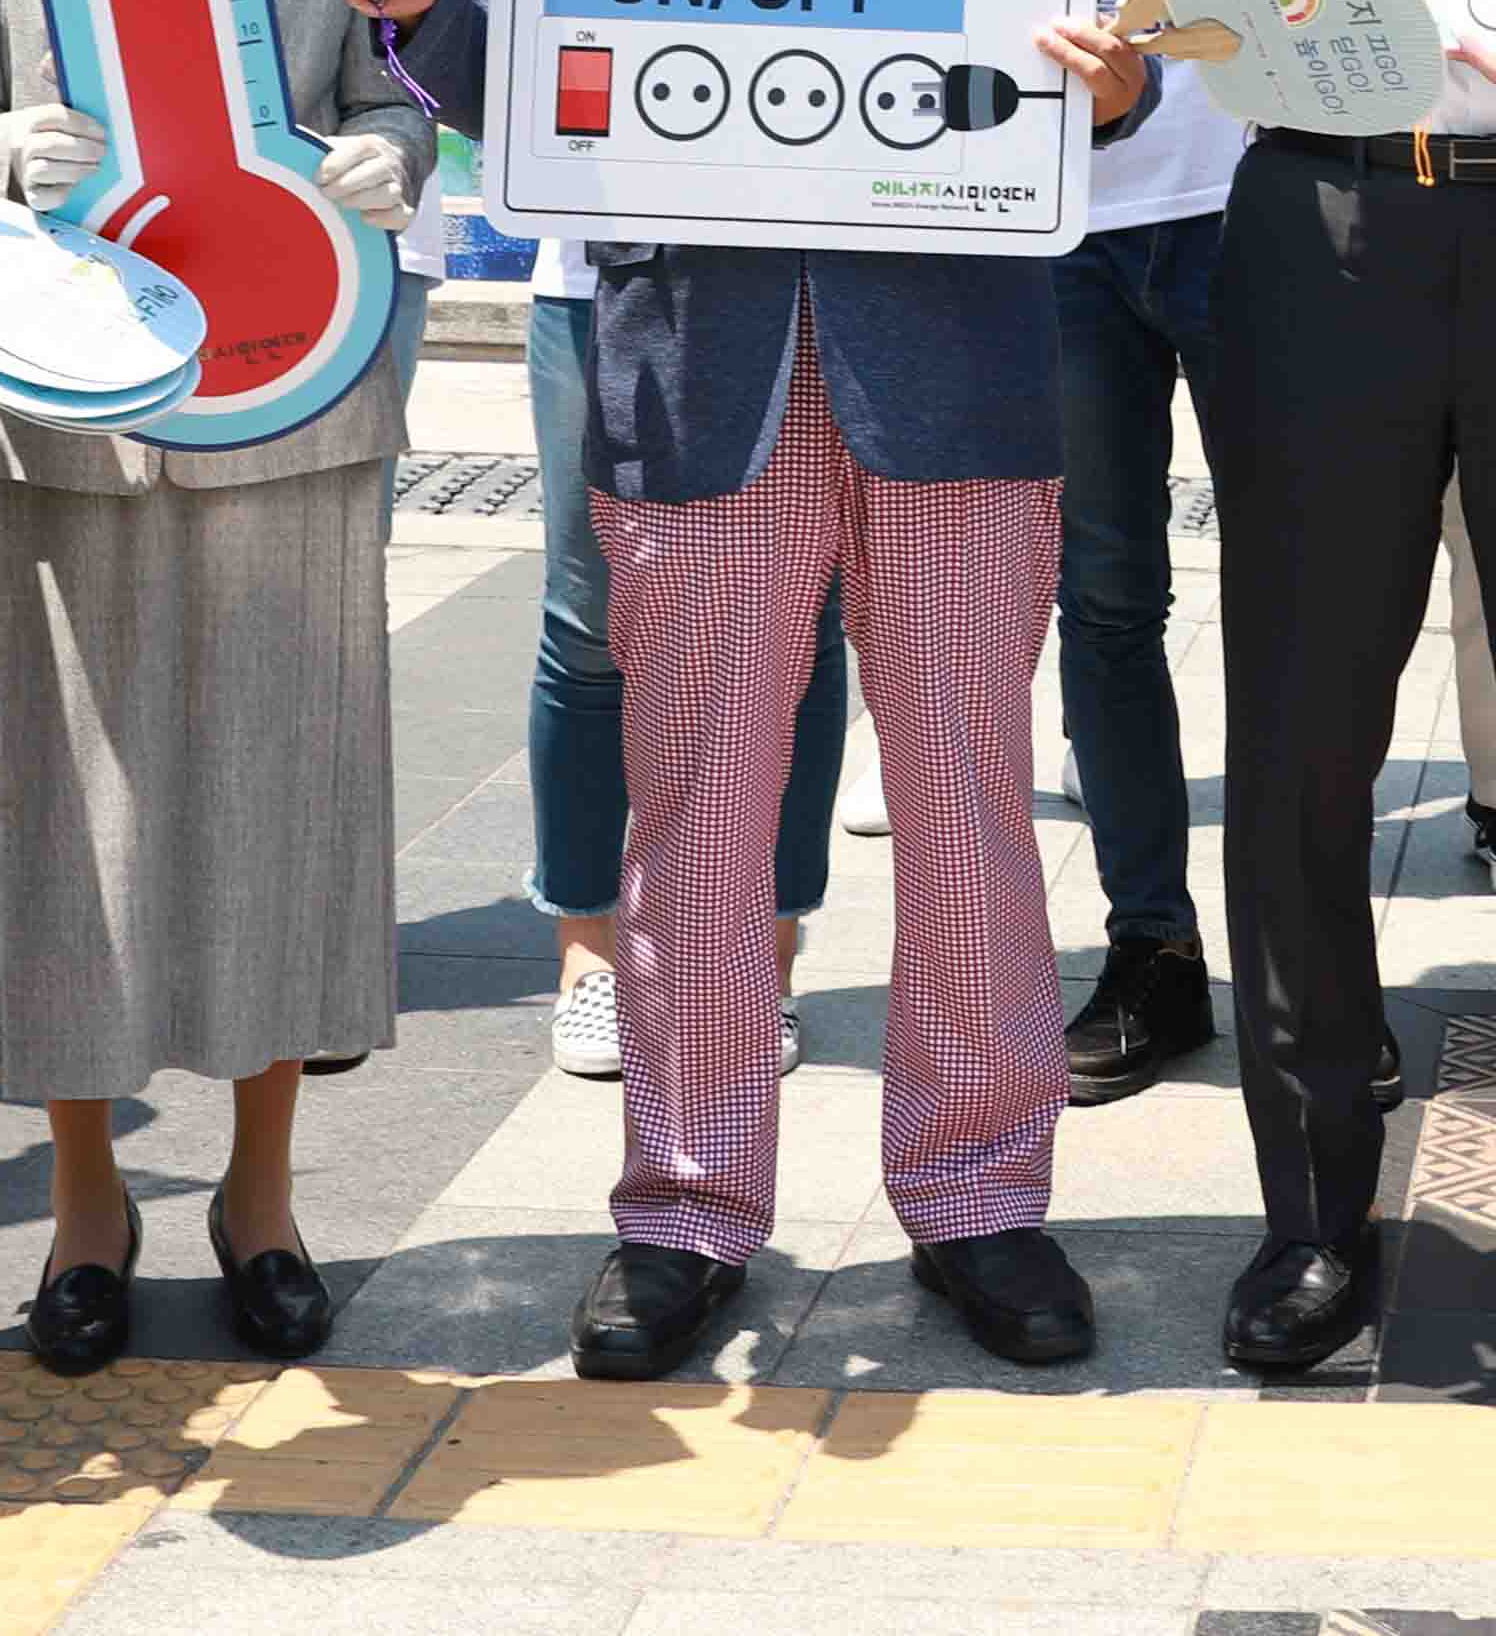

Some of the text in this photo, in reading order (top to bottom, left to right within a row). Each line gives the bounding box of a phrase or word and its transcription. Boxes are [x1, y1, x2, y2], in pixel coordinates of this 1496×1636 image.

[241, 22, 259, 37] 10
[575, 30, 596, 43] ON
[568, 139, 598, 152] OFF
[872, 180, 1036, 213] 에너지시민연대
